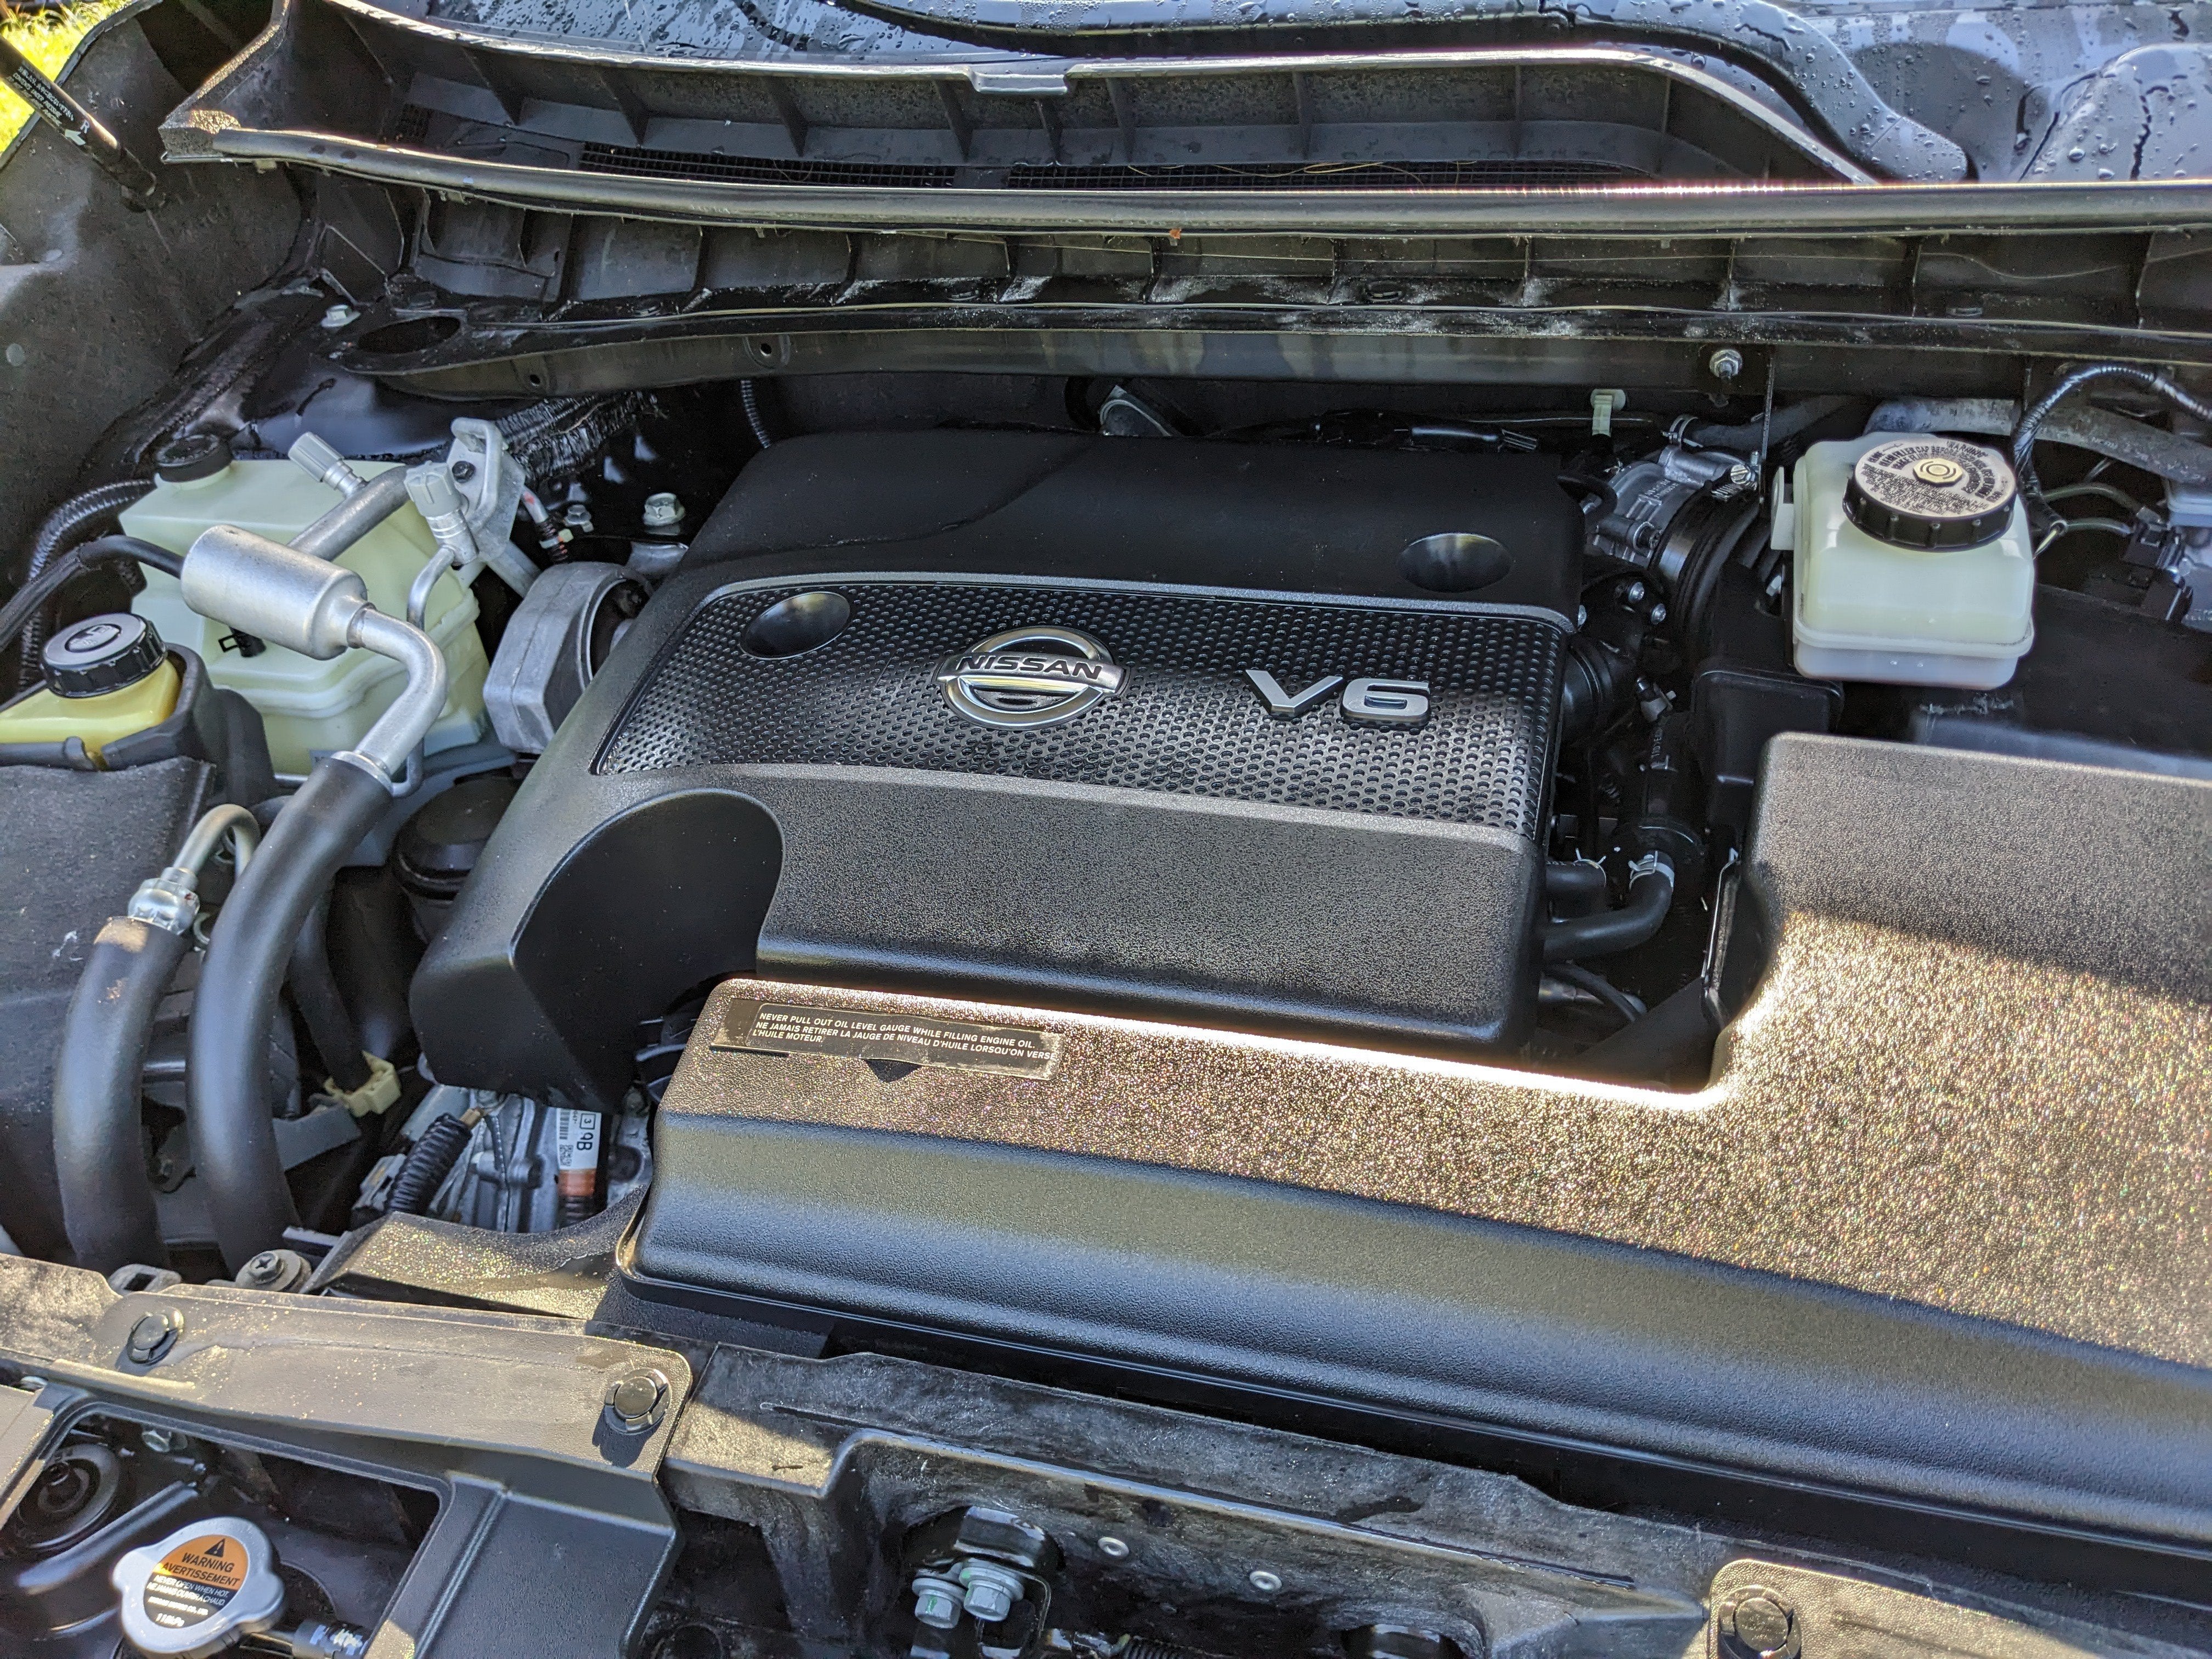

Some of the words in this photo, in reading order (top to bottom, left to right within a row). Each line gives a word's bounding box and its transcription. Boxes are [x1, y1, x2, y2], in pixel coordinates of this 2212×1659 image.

[81, 120, 90, 134] R
[956, 655, 1103, 680] NISSAN
[1244, 669, 1431, 727] V6
[752, 1029, 785, 1039] L'HUILE
[786, 1032, 823, 1043] MOTEUR.
[759, 1013, 788, 1022] NEVER
[789, 1015, 811, 1025] PULL
[814, 1018, 833, 1026] OUT
[834, 1020, 849, 1028] OIL
[851, 1022, 877, 1031] LEVEL
[879, 1024, 911, 1032] GAUGE
[913, 1026, 940, 1038] WHILE
[943, 1031, 978, 1042] FILLING
[980, 1036, 1015, 1046] ENGINE
[1018, 1040, 1035, 1048] OIL.
[769, 1023, 800, 1032] JAMAIS
[803, 1026, 839, 1037] RETIRER
[852, 1031, 882, 1041] JAUGE
[896, 1034, 931, 1046] NIVEAU
[933, 1040, 969, 1051] D'HUILE
[970, 1043, 1024, 1057] LORSQU'ON
[1026, 1051, 1057, 1060] VERSE
[162, 1562, 240, 1587] AVERTISSEMENT
[182, 1552, 235, 1573] WARNING
[153, 1575, 177, 1586] NEVER
[175, 1580, 193, 1590] OPEN
[192, 1583, 216, 1595] WHEN
[215, 1589, 230, 1598] HOT.
[202, 1595, 226, 1606] CHAUD.
